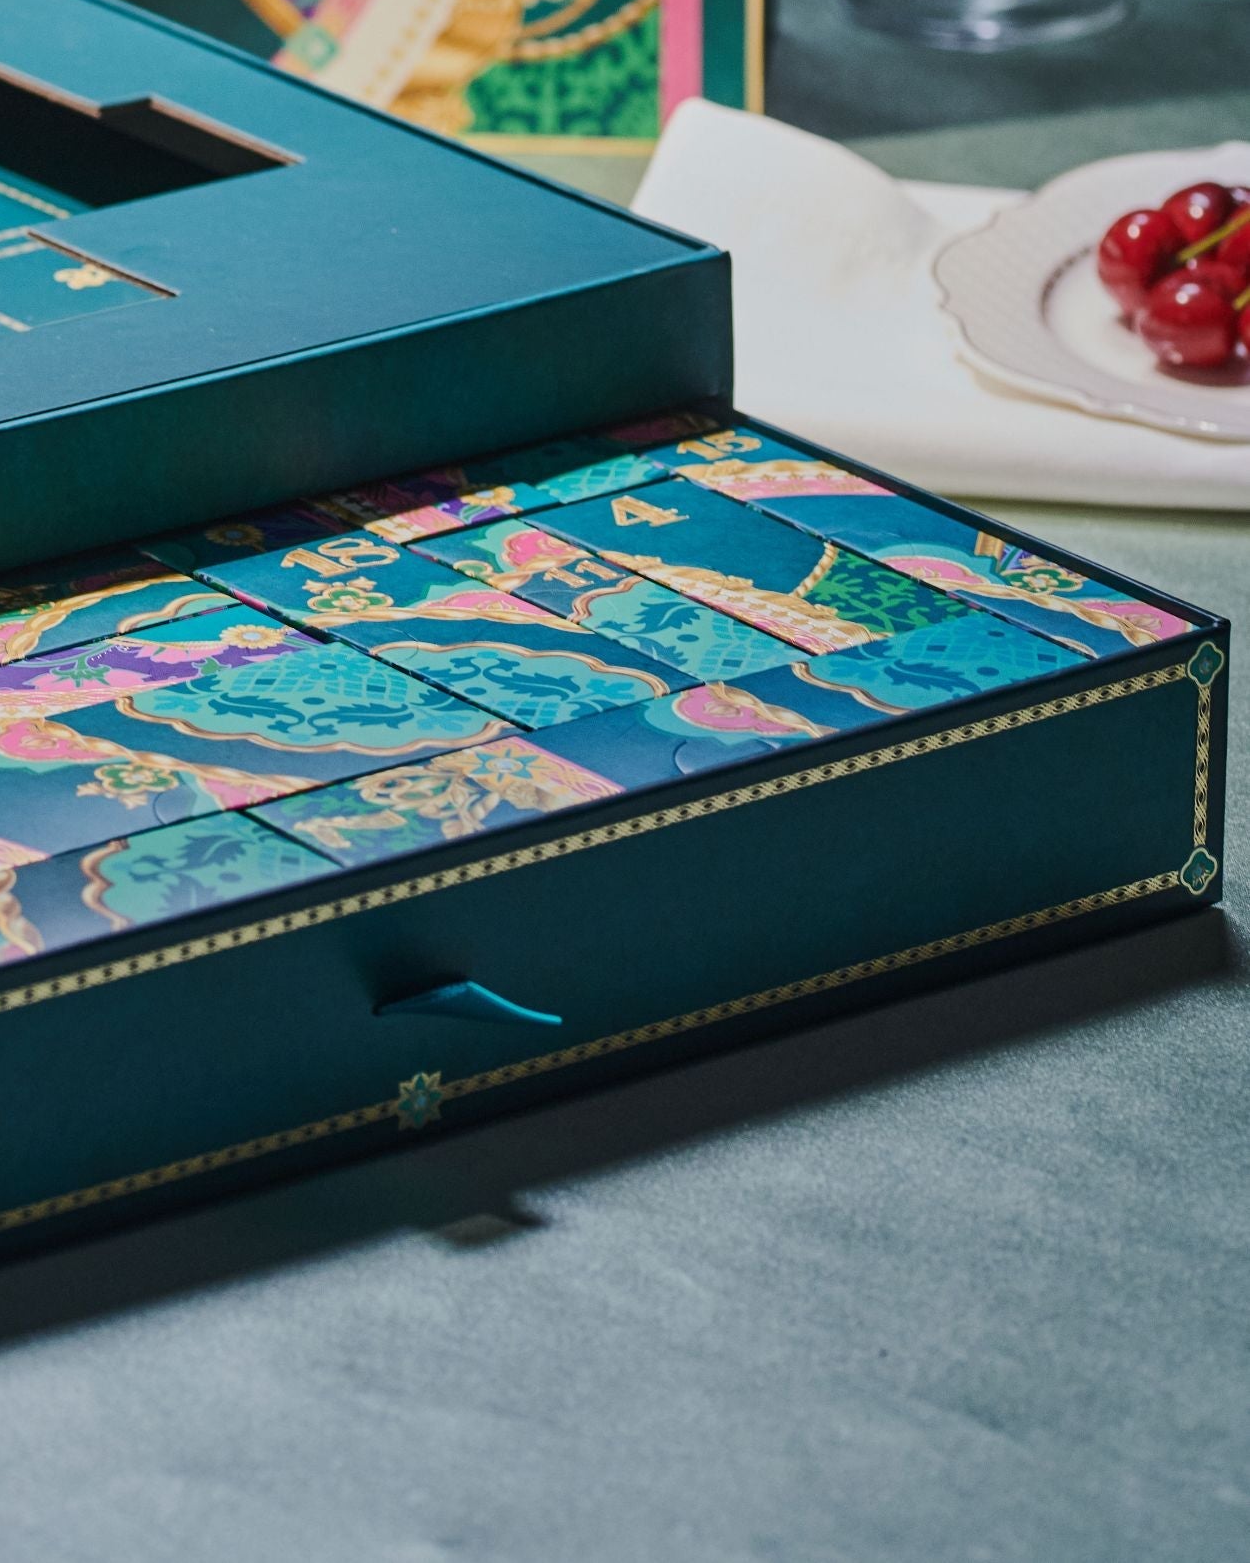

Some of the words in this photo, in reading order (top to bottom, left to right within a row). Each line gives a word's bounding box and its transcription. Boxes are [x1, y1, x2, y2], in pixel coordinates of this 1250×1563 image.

[676, 429, 763, 461] 15
[611, 494, 690, 527] 4
[280, 537, 400, 578] 18
[543, 559, 626, 589] 11
